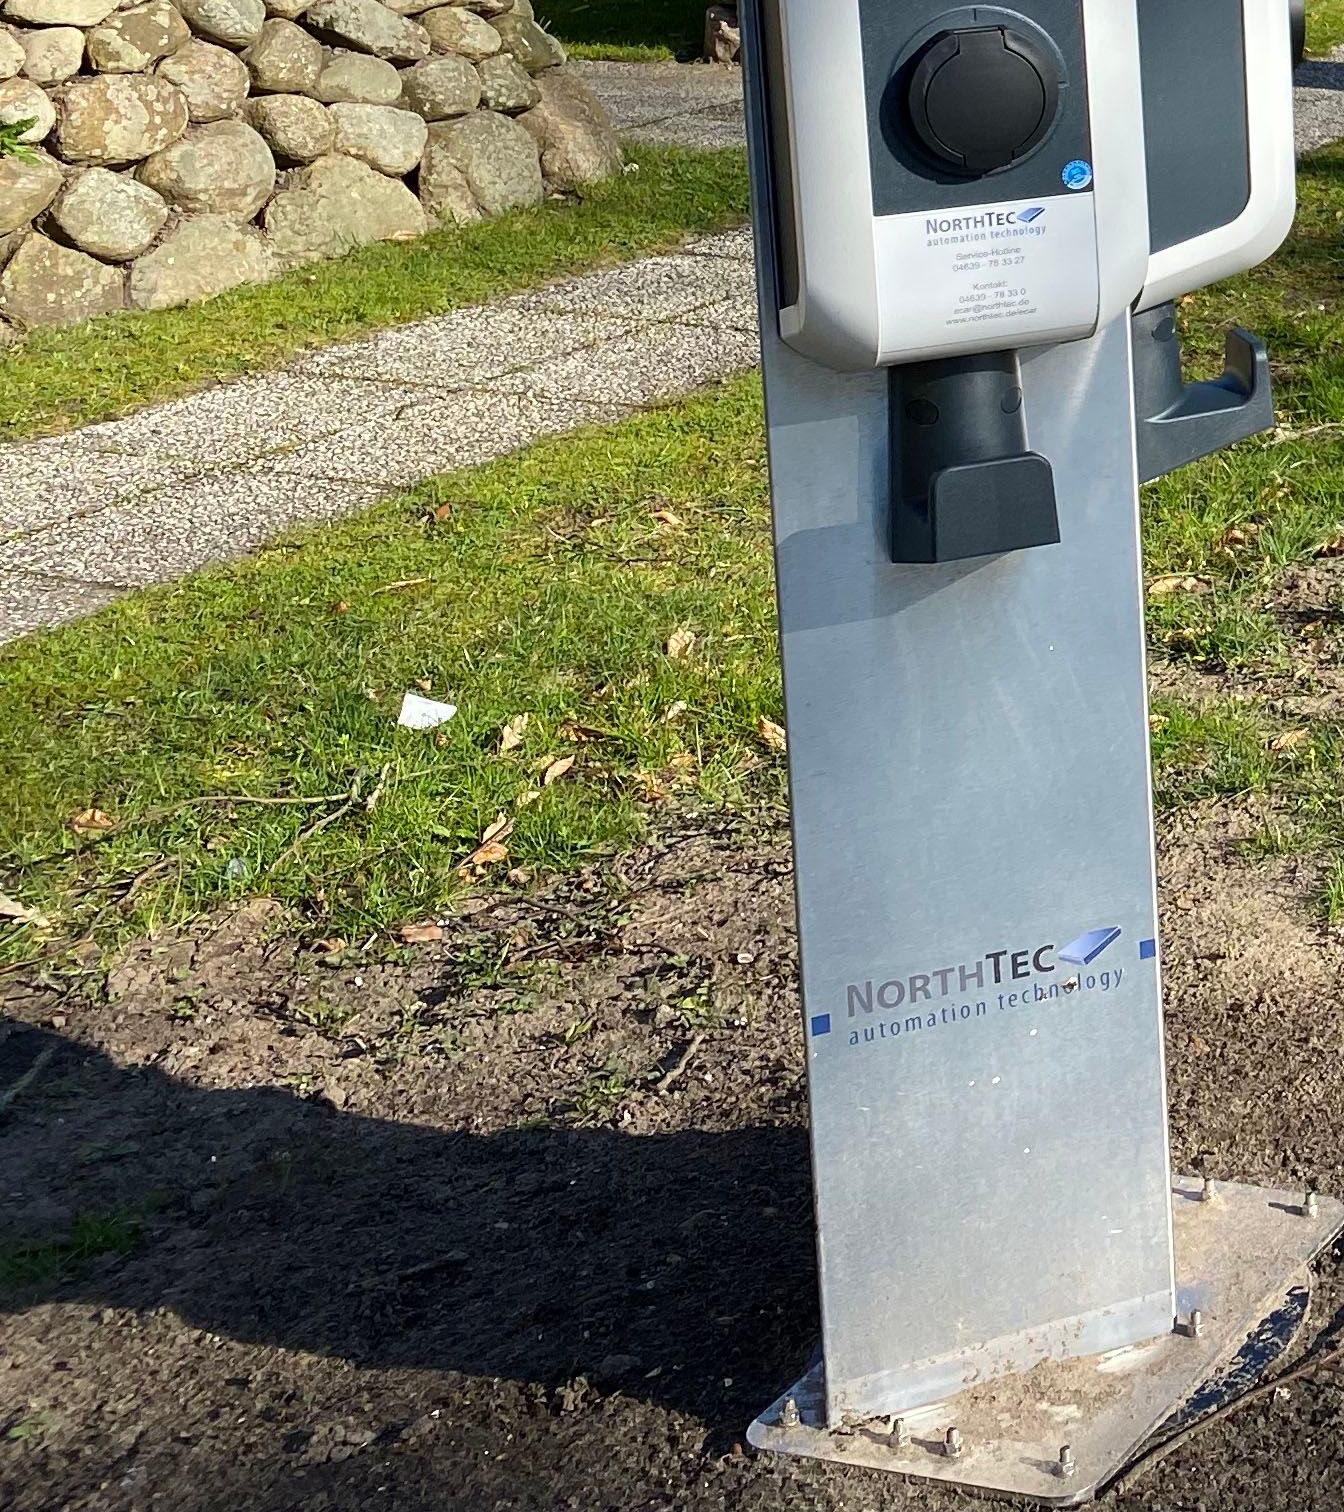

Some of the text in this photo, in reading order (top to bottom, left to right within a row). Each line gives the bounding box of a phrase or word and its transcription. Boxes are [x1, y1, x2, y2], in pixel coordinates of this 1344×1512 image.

[926, 212, 1017, 235] NORTHTEC
[926, 225, 1047, 247] automation technology
[955, 247, 1022, 261] Service-Hotline
[952, 262, 981, 273] 04639
[1001, 258, 1013, 266] 33
[1014, 256, 1025, 264] 27
[972, 281, 1008, 291] Kontakt:
[1007, 289, 1018, 297] 33
[1020, 287, 1026, 296] 0
[847, 944, 1055, 1018] NORTHTEC
[849, 967, 1124, 1046] automation technology
